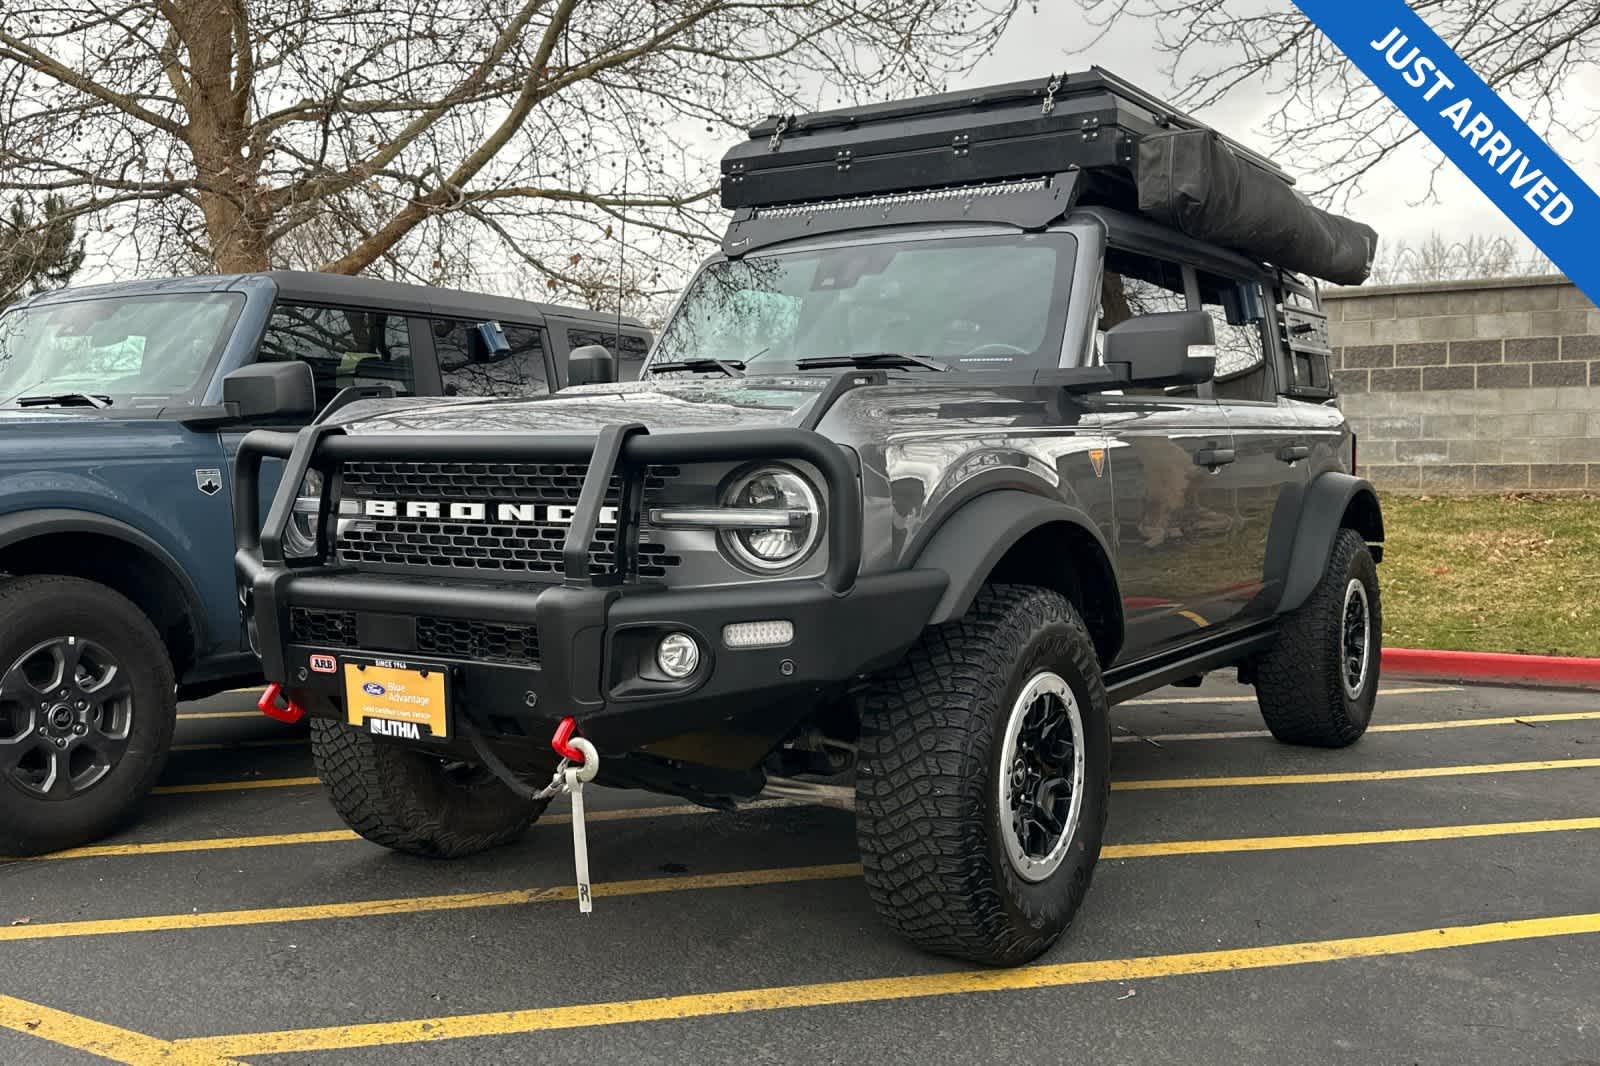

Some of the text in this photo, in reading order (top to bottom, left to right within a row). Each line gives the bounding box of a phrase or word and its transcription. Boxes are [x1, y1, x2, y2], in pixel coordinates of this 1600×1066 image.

[314, 658, 334, 669] ARB
[365, 682, 384, 695] Ford
[387, 681, 406, 692] Blue
[389, 693, 429, 706] Advantage
[382, 718, 420, 739] LITHIA
